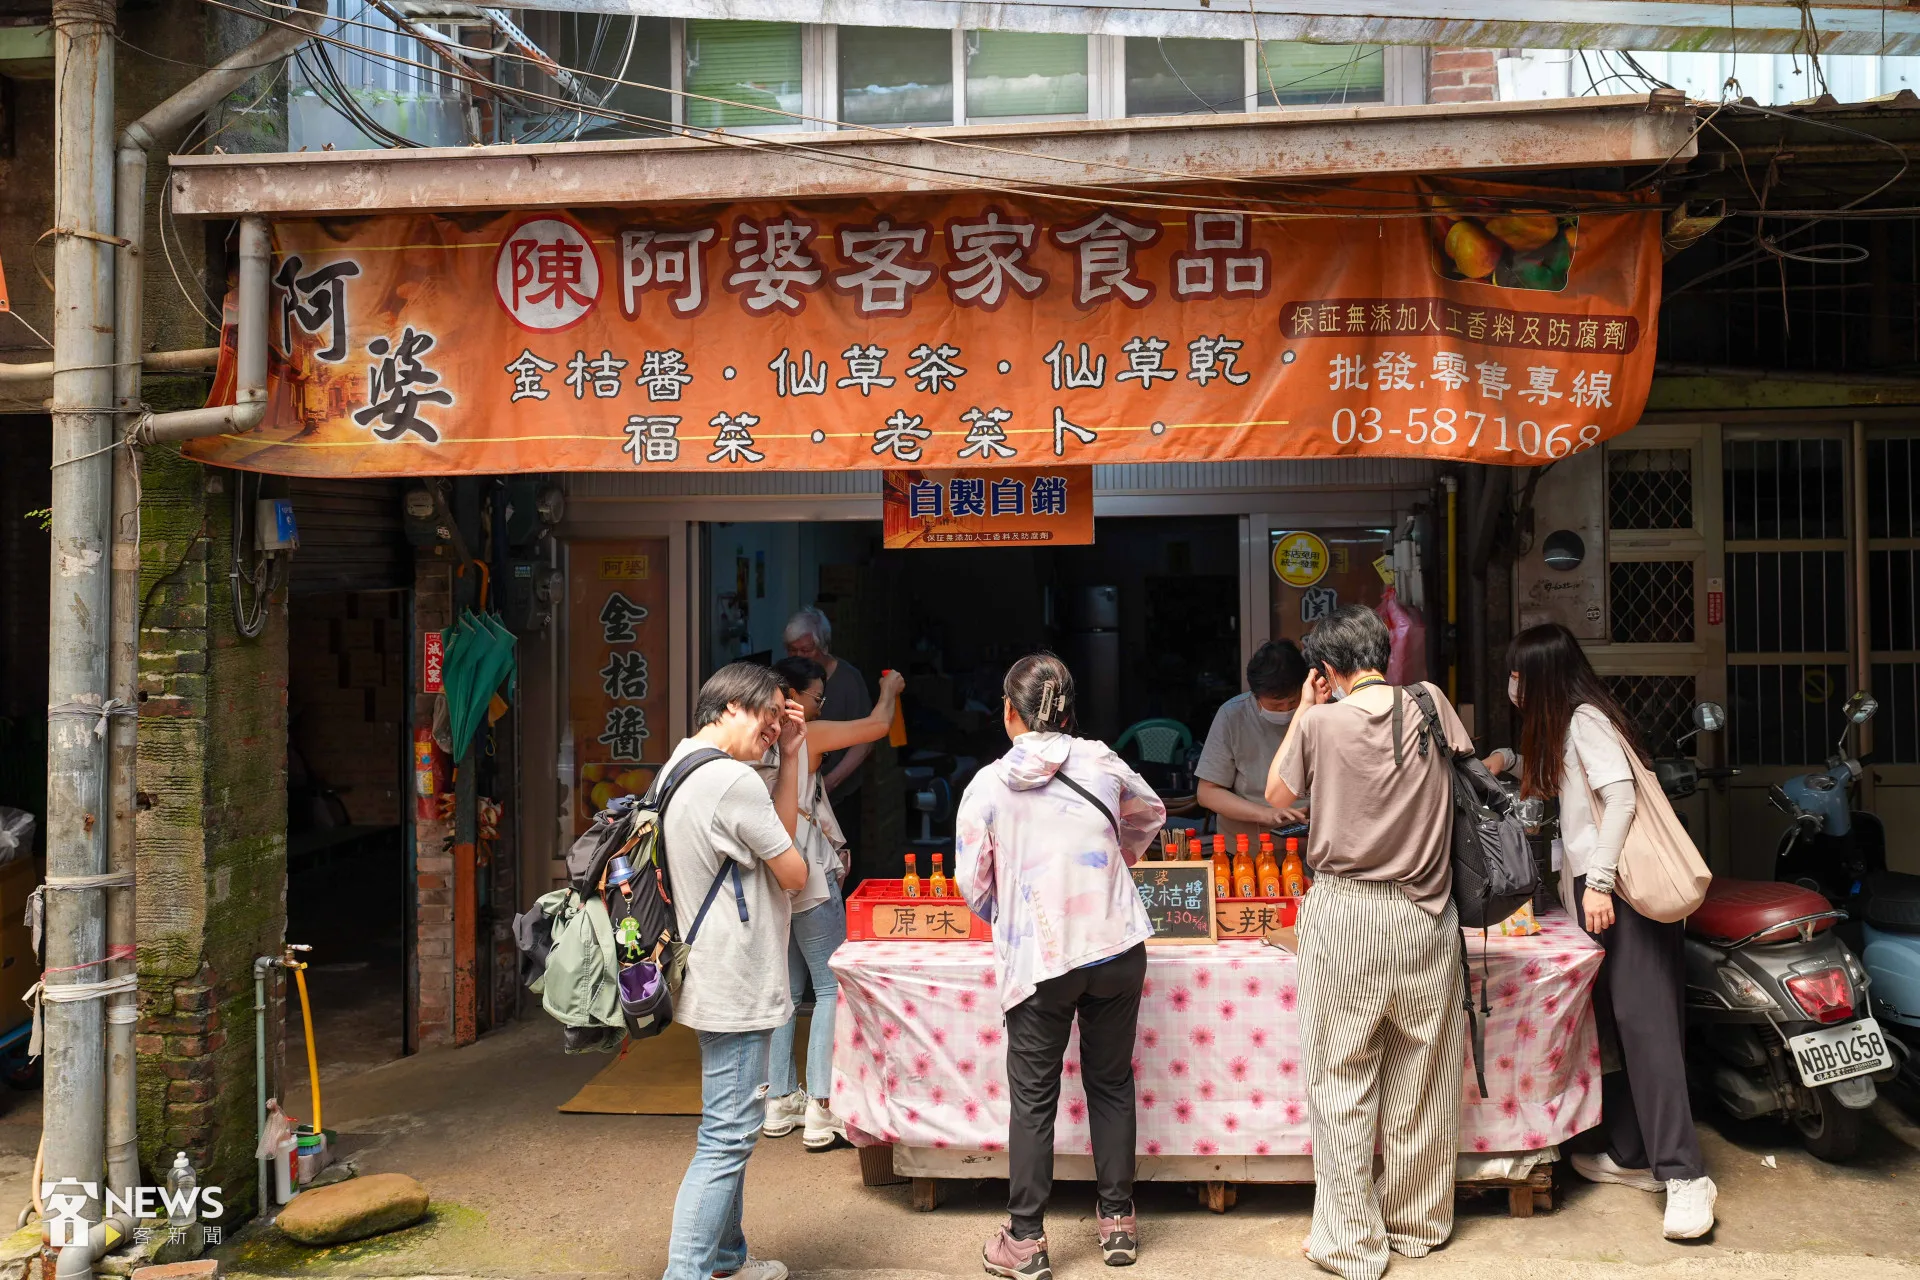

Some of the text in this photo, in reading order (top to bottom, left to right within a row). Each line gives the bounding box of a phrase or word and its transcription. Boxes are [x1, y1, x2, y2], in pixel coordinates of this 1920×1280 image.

[510, 212, 1264, 315] 陳 阿婆客家食品
[274, 255, 455, 444] 阿婆
[1331, 407, 1601, 459] 03-5871068
[909, 476, 1068, 518] 自製自銷
[427, 642, 442, 683] 滅火器
[599, 592, 649, 760] 金桔醬
[889, 908, 966, 936] 原味
